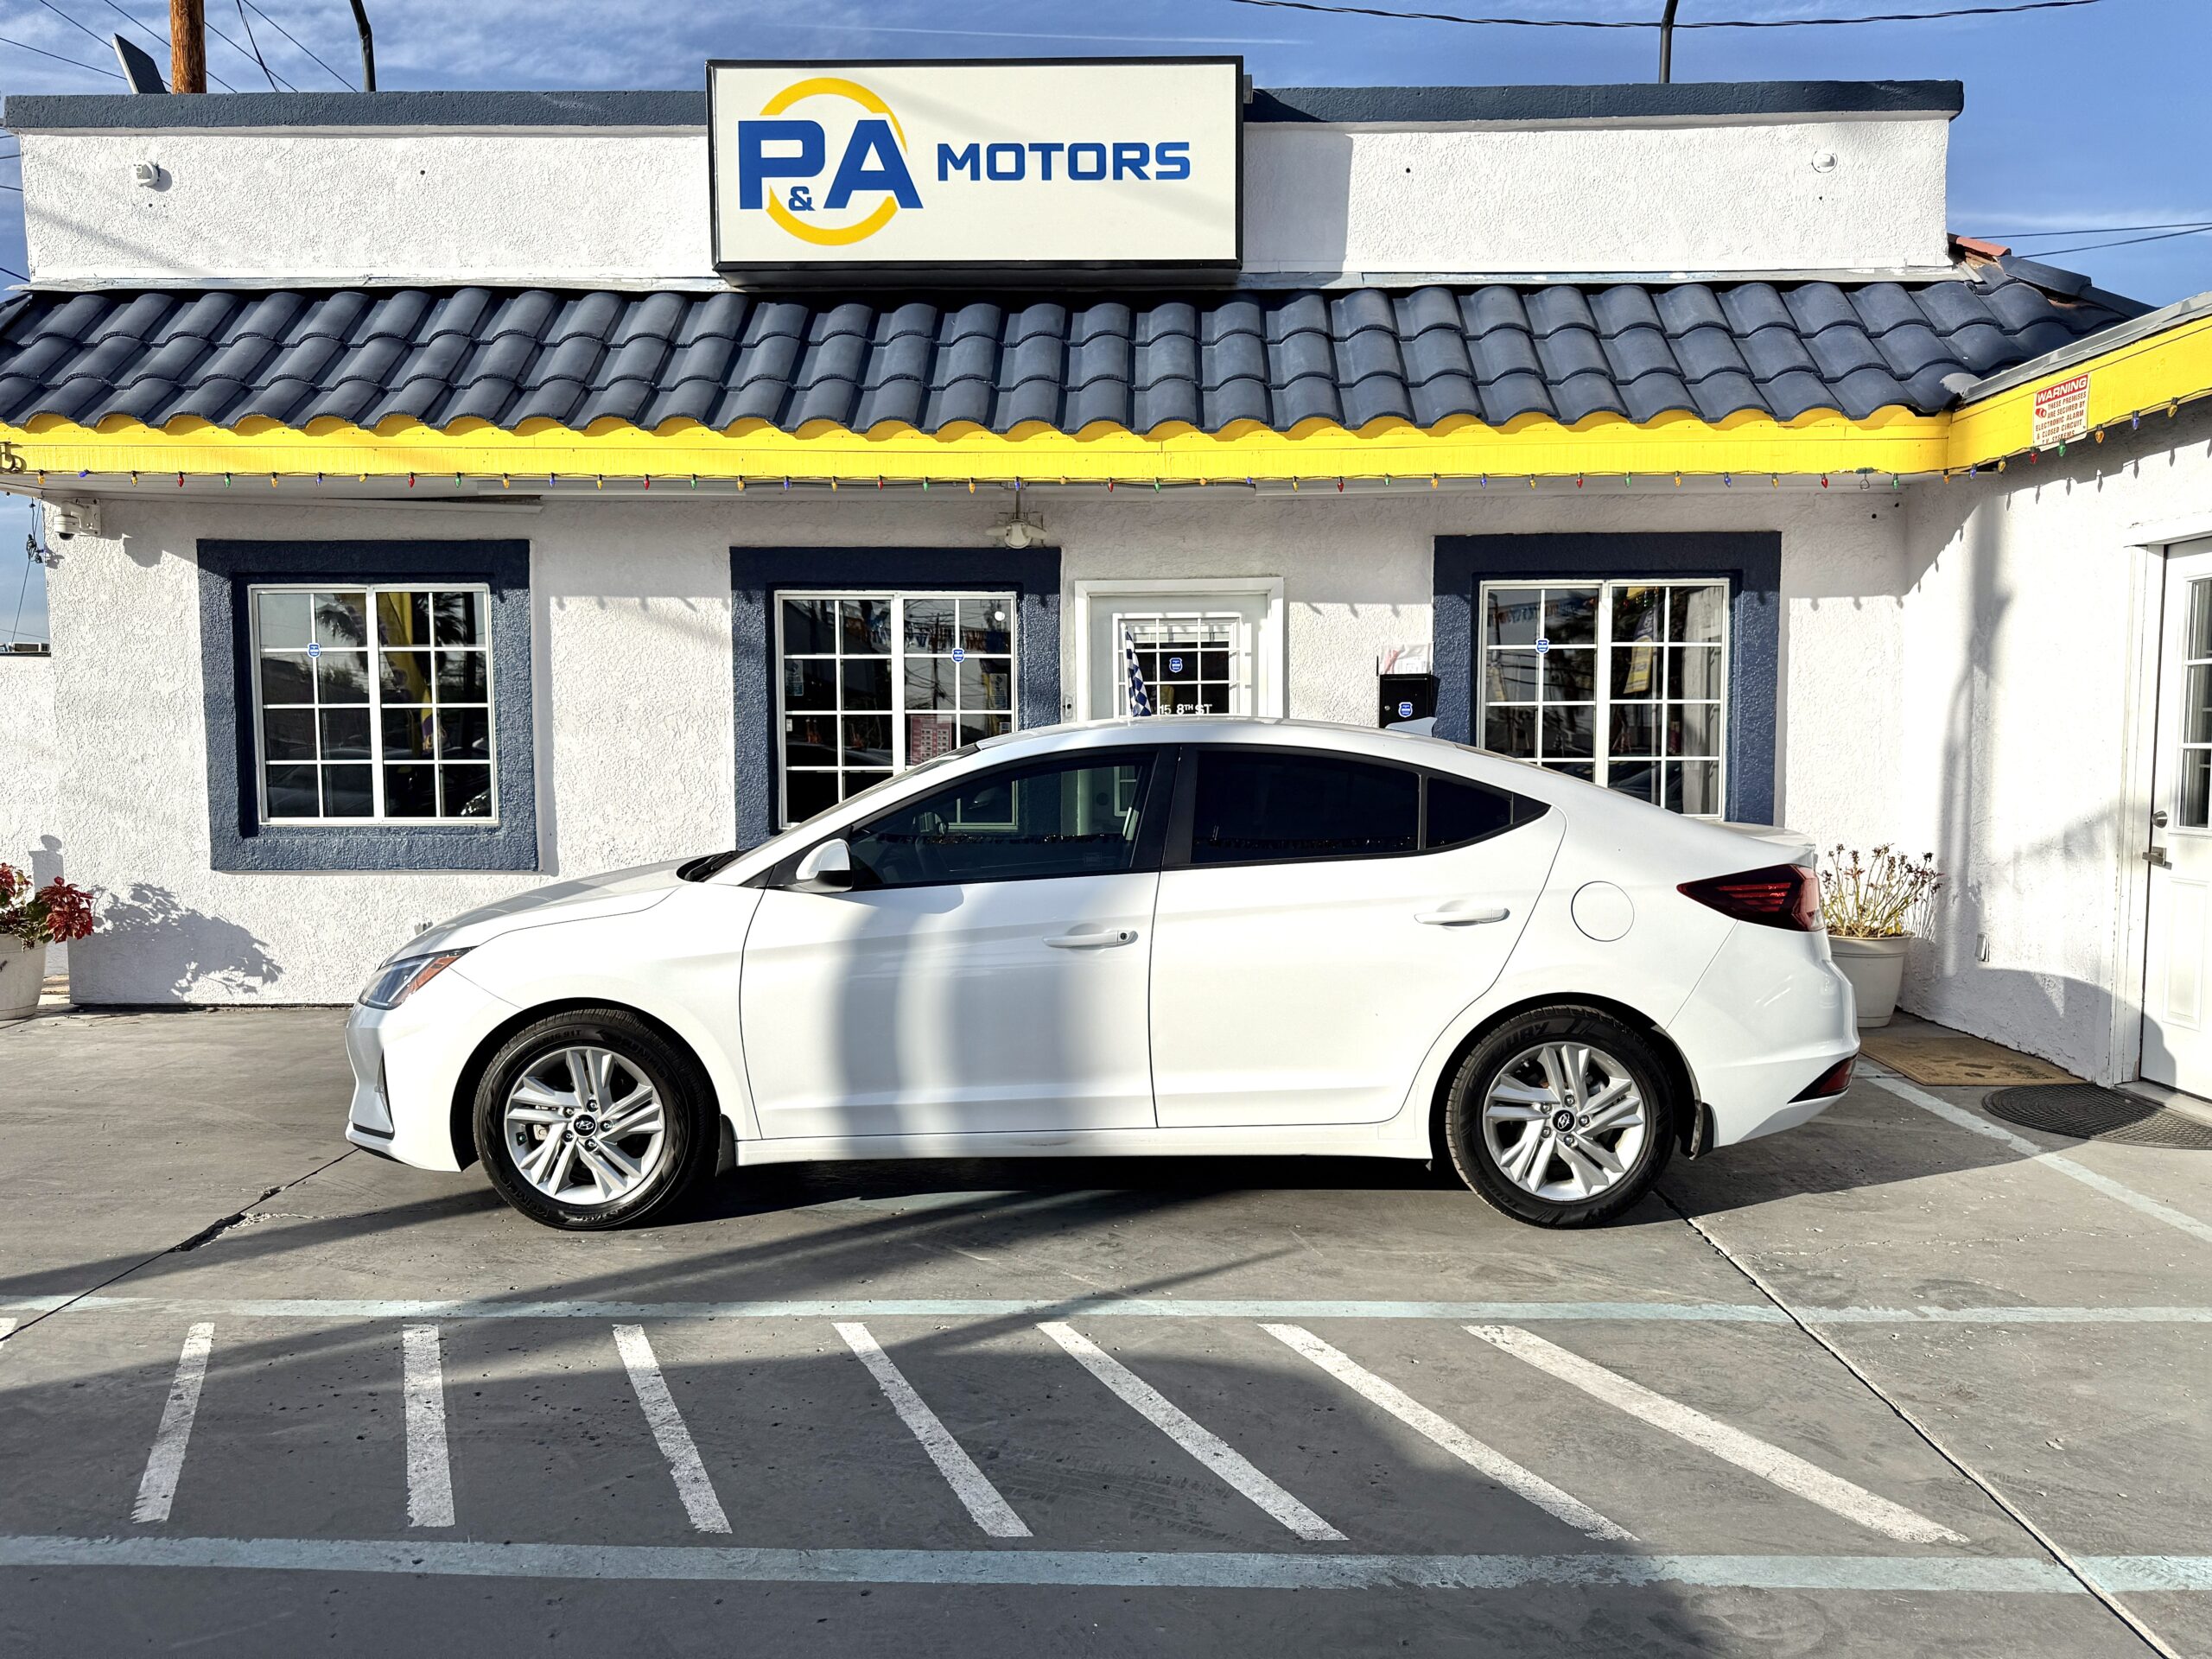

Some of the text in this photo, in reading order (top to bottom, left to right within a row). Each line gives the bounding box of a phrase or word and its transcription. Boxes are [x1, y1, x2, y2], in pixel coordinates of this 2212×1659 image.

[938, 142, 1191, 181] MOTORS
[2037, 377, 2088, 404] WARNING
[2048, 391, 2087, 410] THESE PREMISES
[2048, 400, 2085, 419] ARE SECURED BY
[2036, 410, 2084, 432] ELECTRONIC ALARM
[2042, 426, 2060, 438] CLOSED
[2062, 419, 2082, 431] CIRCUIT
